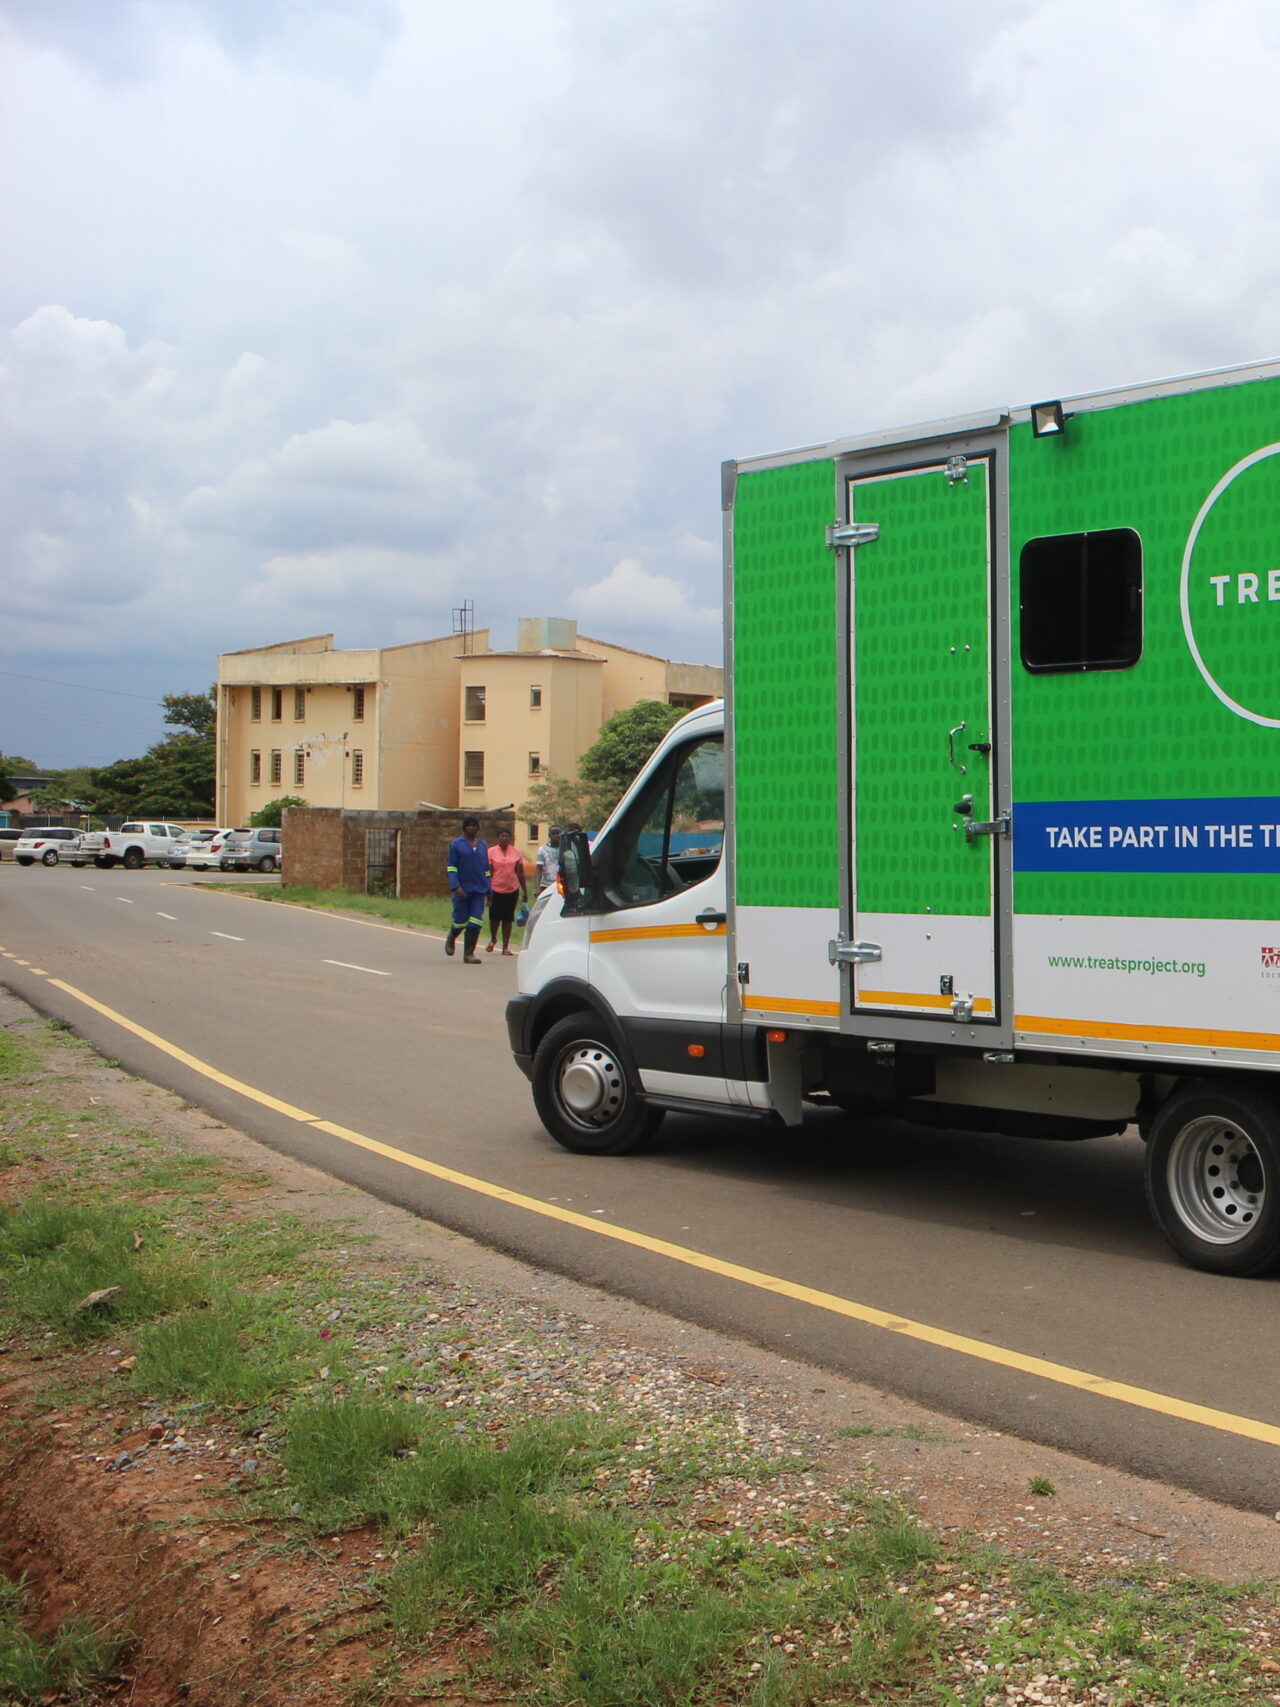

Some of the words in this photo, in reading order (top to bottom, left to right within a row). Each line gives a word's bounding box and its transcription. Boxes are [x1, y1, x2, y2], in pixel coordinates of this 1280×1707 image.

[1046, 826, 1103, 848] TAKE
[1109, 826, 1169, 848] PART
[1174, 825, 1198, 848] IN
[1204, 825, 1253, 848] THE
[1048, 955, 1206, 977] www.treatsproject.org
